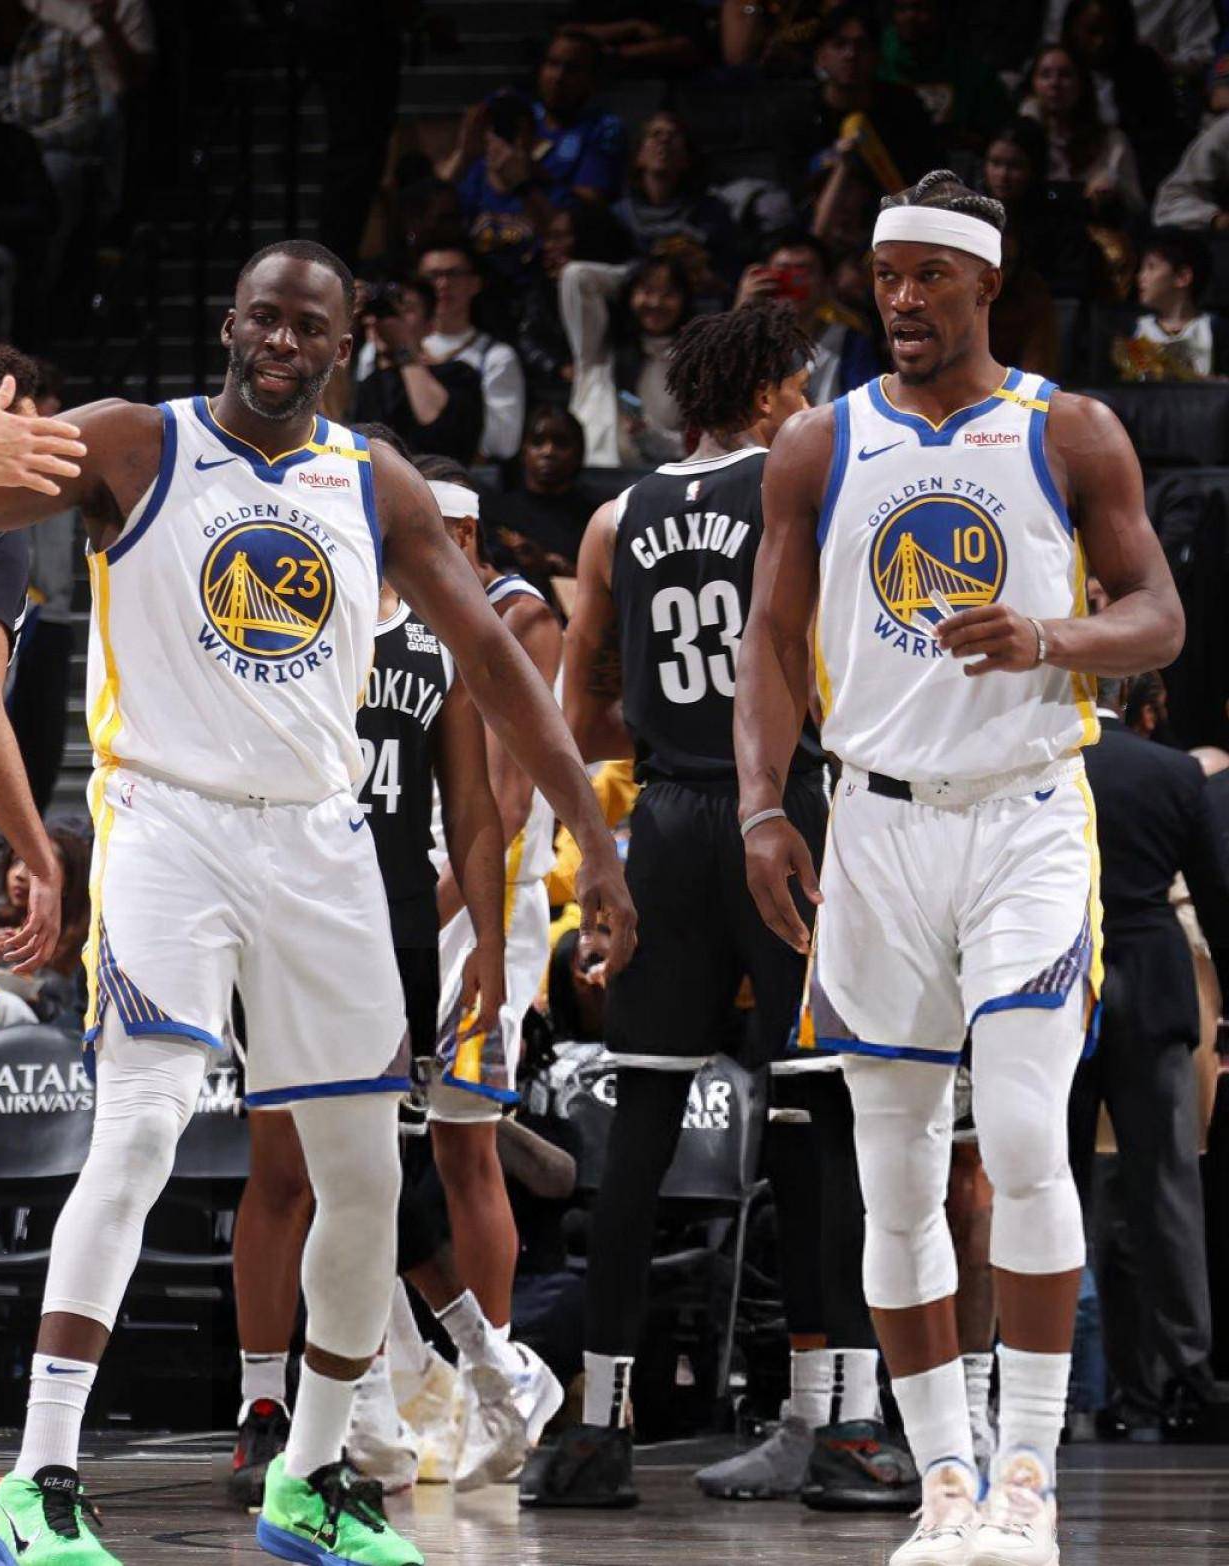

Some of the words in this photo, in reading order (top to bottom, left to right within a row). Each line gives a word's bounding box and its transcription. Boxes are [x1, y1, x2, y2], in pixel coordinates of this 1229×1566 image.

[964, 432, 1020, 446] Rakuten
[298, 472, 351, 488] Rakuten
[868, 477, 943, 527] GOLDEN
[953, 479, 1006, 516] STATE
[203, 504, 279, 538] GOLDEN
[289, 509, 338, 557] STATE
[630, 512, 750, 569] CLAXTON
[953, 526, 986, 564] 10
[274, 557, 322, 599] 23
[405, 623, 425, 633] GET
[406, 631, 436, 644] YOUR
[407, 641, 440, 655] GUIDE
[651, 580, 743, 704] 33
[874, 612, 943, 658] WARR
[198, 623, 333, 684] WARRIORS
[365, 668, 443, 731] OKLYN
[352, 738, 401, 814] 24
